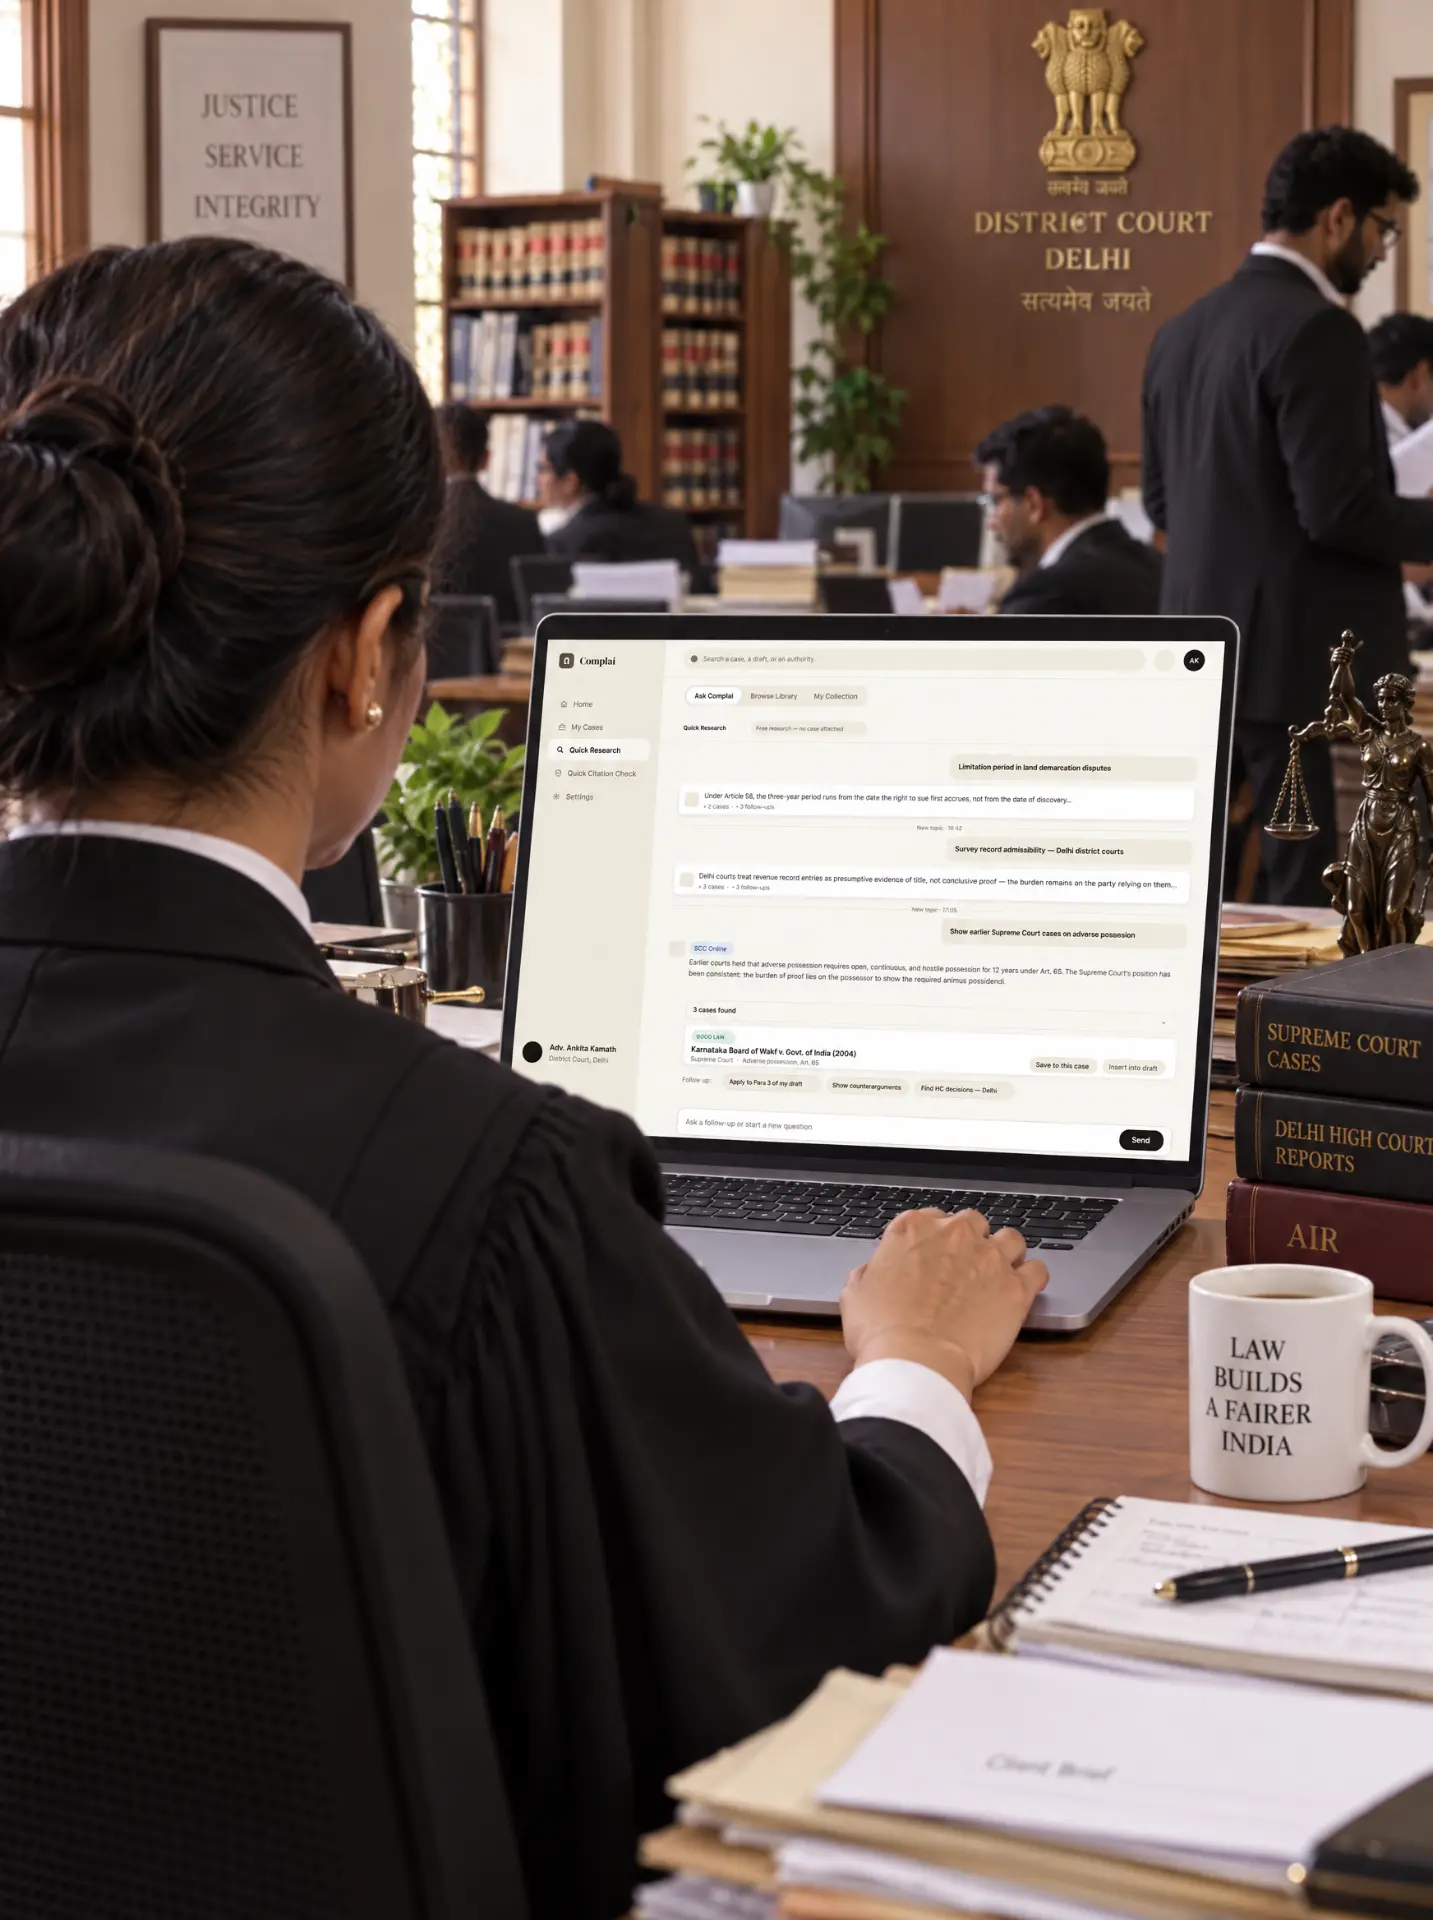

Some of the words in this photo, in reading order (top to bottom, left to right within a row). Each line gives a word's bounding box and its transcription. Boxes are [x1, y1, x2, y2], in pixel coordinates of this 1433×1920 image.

[201, 93, 298, 119] JUSTICE
[205, 144, 304, 168] SERVICE
[195, 194, 321, 219] INTEGRITY
[974, 211, 1107, 234] DISTRICT
[1117, 211, 1213, 234] COURT
[1045, 248, 1131, 270] DELHI
[1020, 286, 1094, 312] सत्यमेव
[1101, 286, 1153, 312] जयते
[580, 656, 616, 668] Complai
[694, 692, 707, 700] Ask
[707, 692, 734, 701] Complai
[750, 692, 774, 700] Browse
[775, 693, 798, 701] Library
[813, 693, 825, 701] My
[825, 692, 858, 700] Collection
[571, 724, 582, 732] My
[583, 723, 604, 731] Cases
[569, 746, 589, 754] Quick
[590, 746, 621, 754] Research
[568, 769, 587, 777] Quick
[615, 770, 637, 778] Check
[958, 763, 992, 771] Limitation
[992, 763, 1015, 772] period
[1039, 764, 1081, 772] demarcation
[1082, 764, 1112, 773] disputes
[566, 793, 594, 802] Settings
[704, 792, 723, 800] Under
[767, 793, 800, 801] three-year
[801, 793, 822, 801] period
[881, 794, 892, 802] the
[893, 794, 908, 803] right
[930, 794, 943, 802] first
[984, 795, 1000, 803] from
[955, 845, 979, 854] Survey
[1003, 846, 1046, 855] admissibility
[1075, 847, 1100, 855] district
[950, 928, 969, 936] Show
[969, 928, 990, 936] earlier
[992, 929, 1021, 938] Supreme
[1022, 929, 1041, 937] Court
[1072, 930, 1100, 938] adverse
[688, 958, 710, 966] Earlier
[747, 960, 760, 968] that
[761, 961, 786, 969] adverse
[786, 962, 823, 970] possession
[823, 962, 850, 971] requires
[850, 964, 869, 972] open,
[870, 963, 907, 972] continuous,
[945, 965, 981, 974] possession
[992, 966, 1000, 974] 12
[1019, 967, 1039, 975] under
[1065, 968, 1078, 976] The
[1078, 969, 1108, 978] Supreme
[1132, 971, 1158, 979] position
[549, 1043, 565, 1051] Adv.
[566, 1044, 589, 1052] Ankita
[590, 1045, 617, 1053] Kamath
[1267, 1023, 1351, 1050] SUPREME
[1357, 1034, 1421, 1059] COURT
[691, 1045, 728, 1054] Karnataka
[728, 1046, 750, 1055] Board
[750, 1047, 759, 1055] of
[785, 1048, 804, 1056] Govt.
[805, 1049, 813, 1057] of
[813, 1049, 832, 1057] India
[832, 1049, 857, 1059] (2004)
[1036, 1061, 1052, 1069] Save
[1267, 1050, 1322, 1073] CASES
[729, 1078, 746, 1086] Apply
[849, 1083, 902, 1092] counterarguments
[685, 1118, 698, 1126] Ask
[704, 1119, 736, 1128] follow-up
[745, 1121, 761, 1129] start
[783, 1123, 813, 1132] question
[1132, 1136, 1151, 1144] Send
[1275, 1119, 1325, 1143] DELHI
[1329, 1126, 1373, 1148] HIGH
[1376, 1131, 1433, 1156] COURT
[1275, 1147, 1355, 1173] REPORTS
[1287, 1223, 1340, 1254] AIR
[1230, 1336, 1286, 1361] LAW
[1214, 1365, 1303, 1393] BUILDS
[1205, 1397, 1219, 1418] A
[1224, 1399, 1312, 1425] FAIRER
[1221, 1430, 1294, 1457] INDIA
